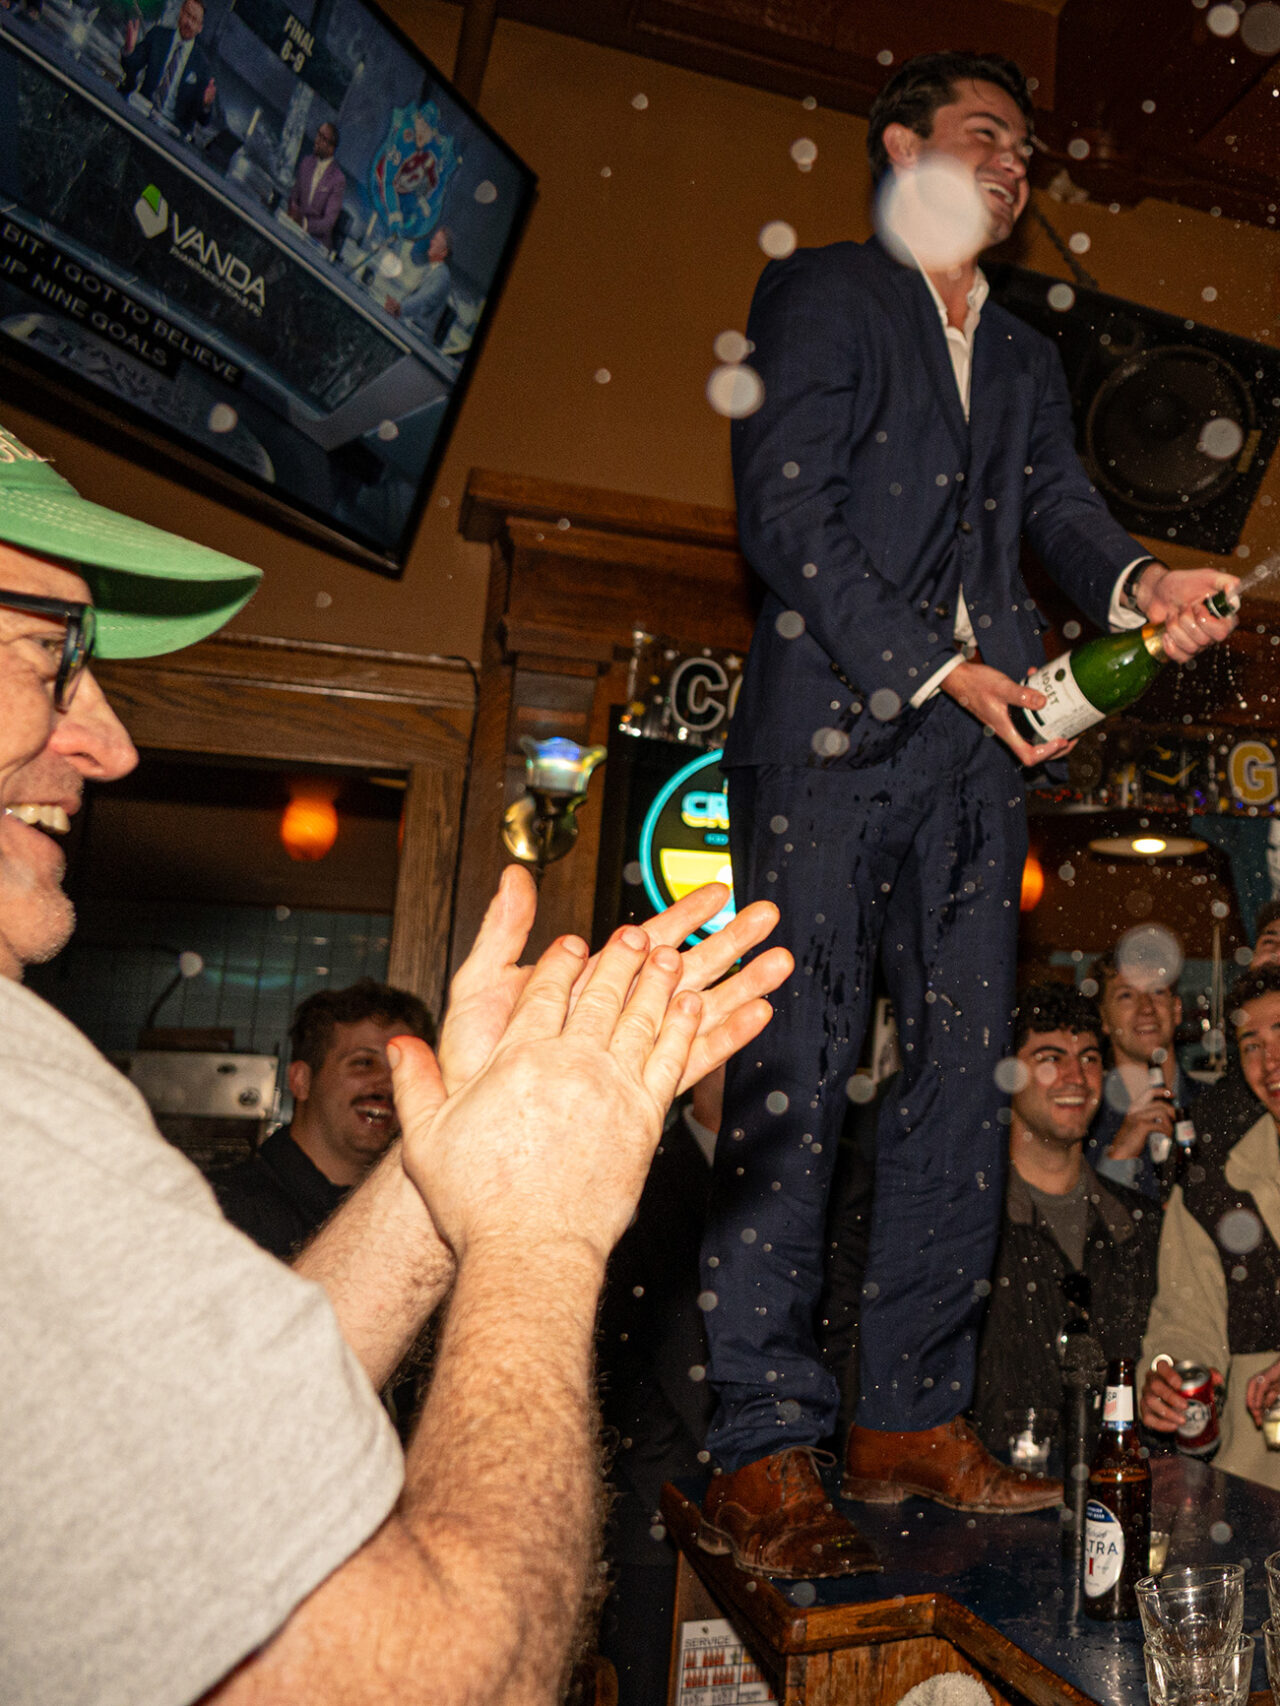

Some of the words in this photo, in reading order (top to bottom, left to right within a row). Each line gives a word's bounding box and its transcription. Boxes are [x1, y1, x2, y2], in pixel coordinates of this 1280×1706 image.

[283, 13, 315, 56] FINAL
[169, 212, 267, 307] VANDA
[31, 275, 88, 318] NINE
[91, 311, 168, 367] GOALS
[62, 263, 118, 306] GOT
[120, 297, 150, 323] TO
[152, 313, 240, 381] BELIEVE
[684, 1635, 730, 1647] SERVICE
